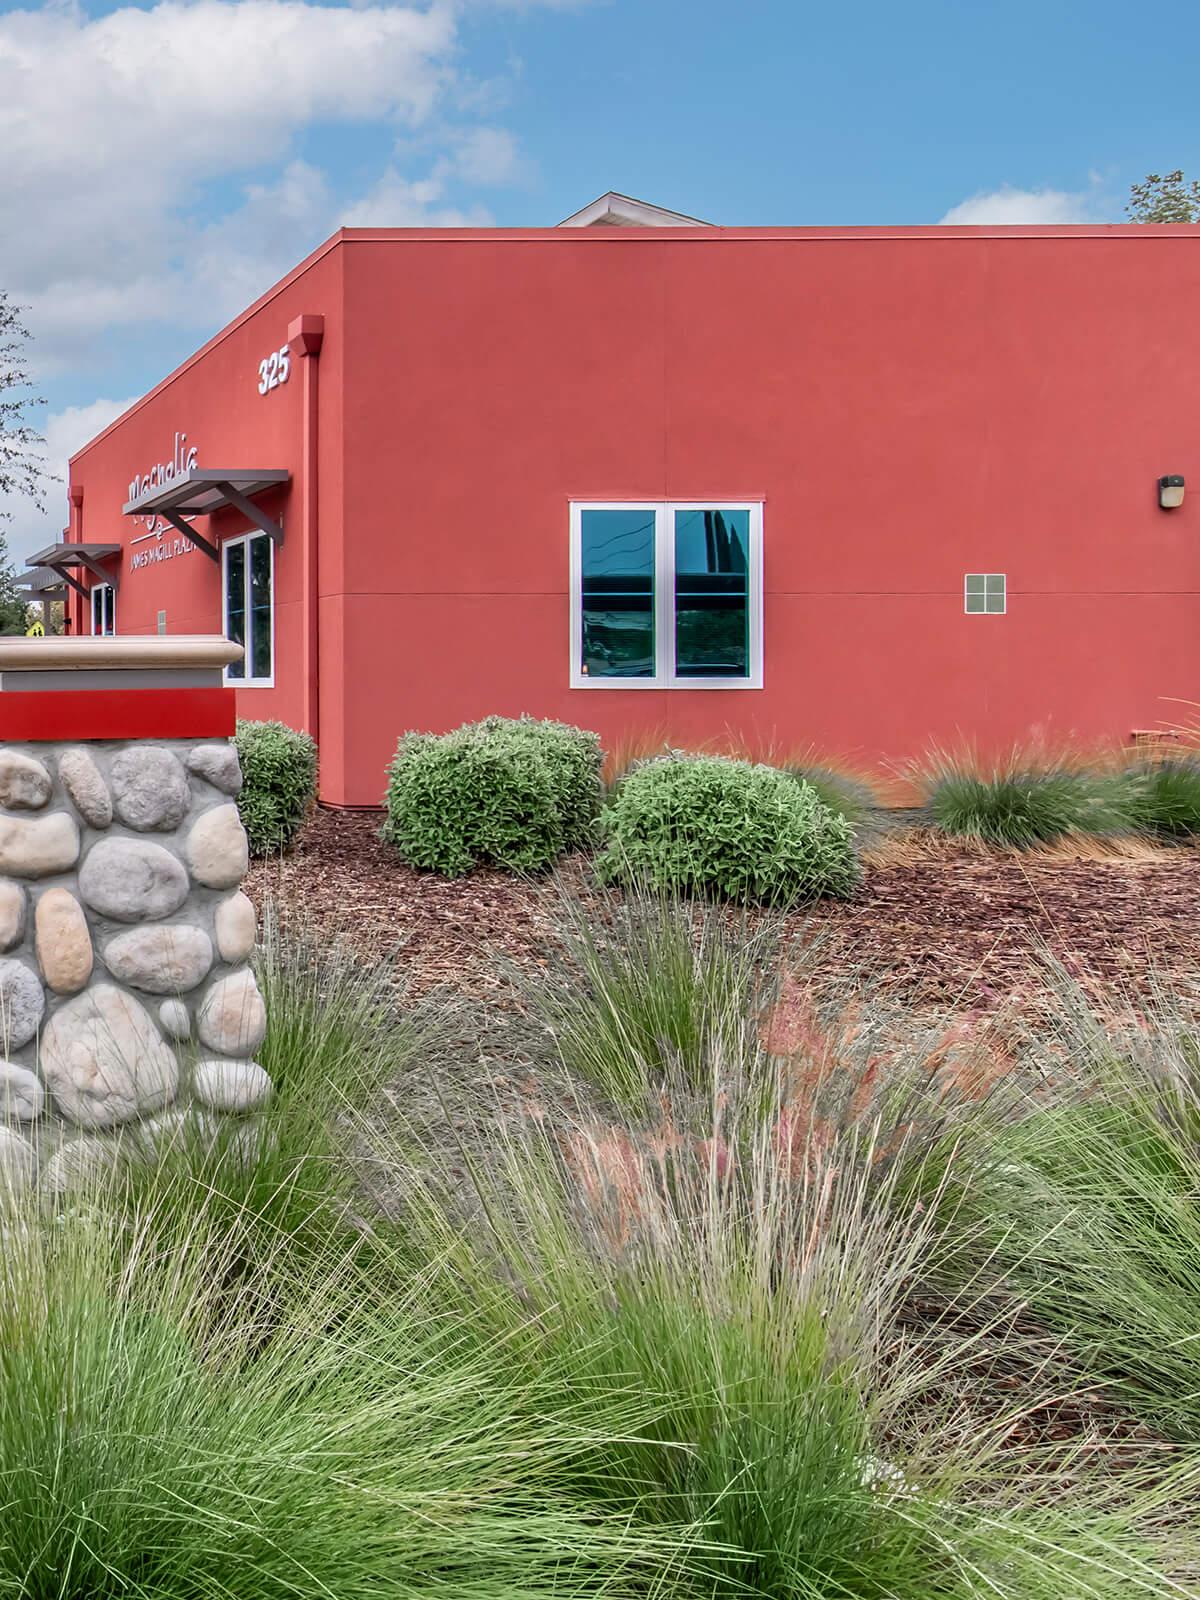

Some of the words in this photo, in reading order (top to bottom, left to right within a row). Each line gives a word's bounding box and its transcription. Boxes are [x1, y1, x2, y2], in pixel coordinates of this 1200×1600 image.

[257, 345, 290, 395] 325
[130, 550, 149, 573] JAMES
[148, 543, 173, 564] MAGILL
